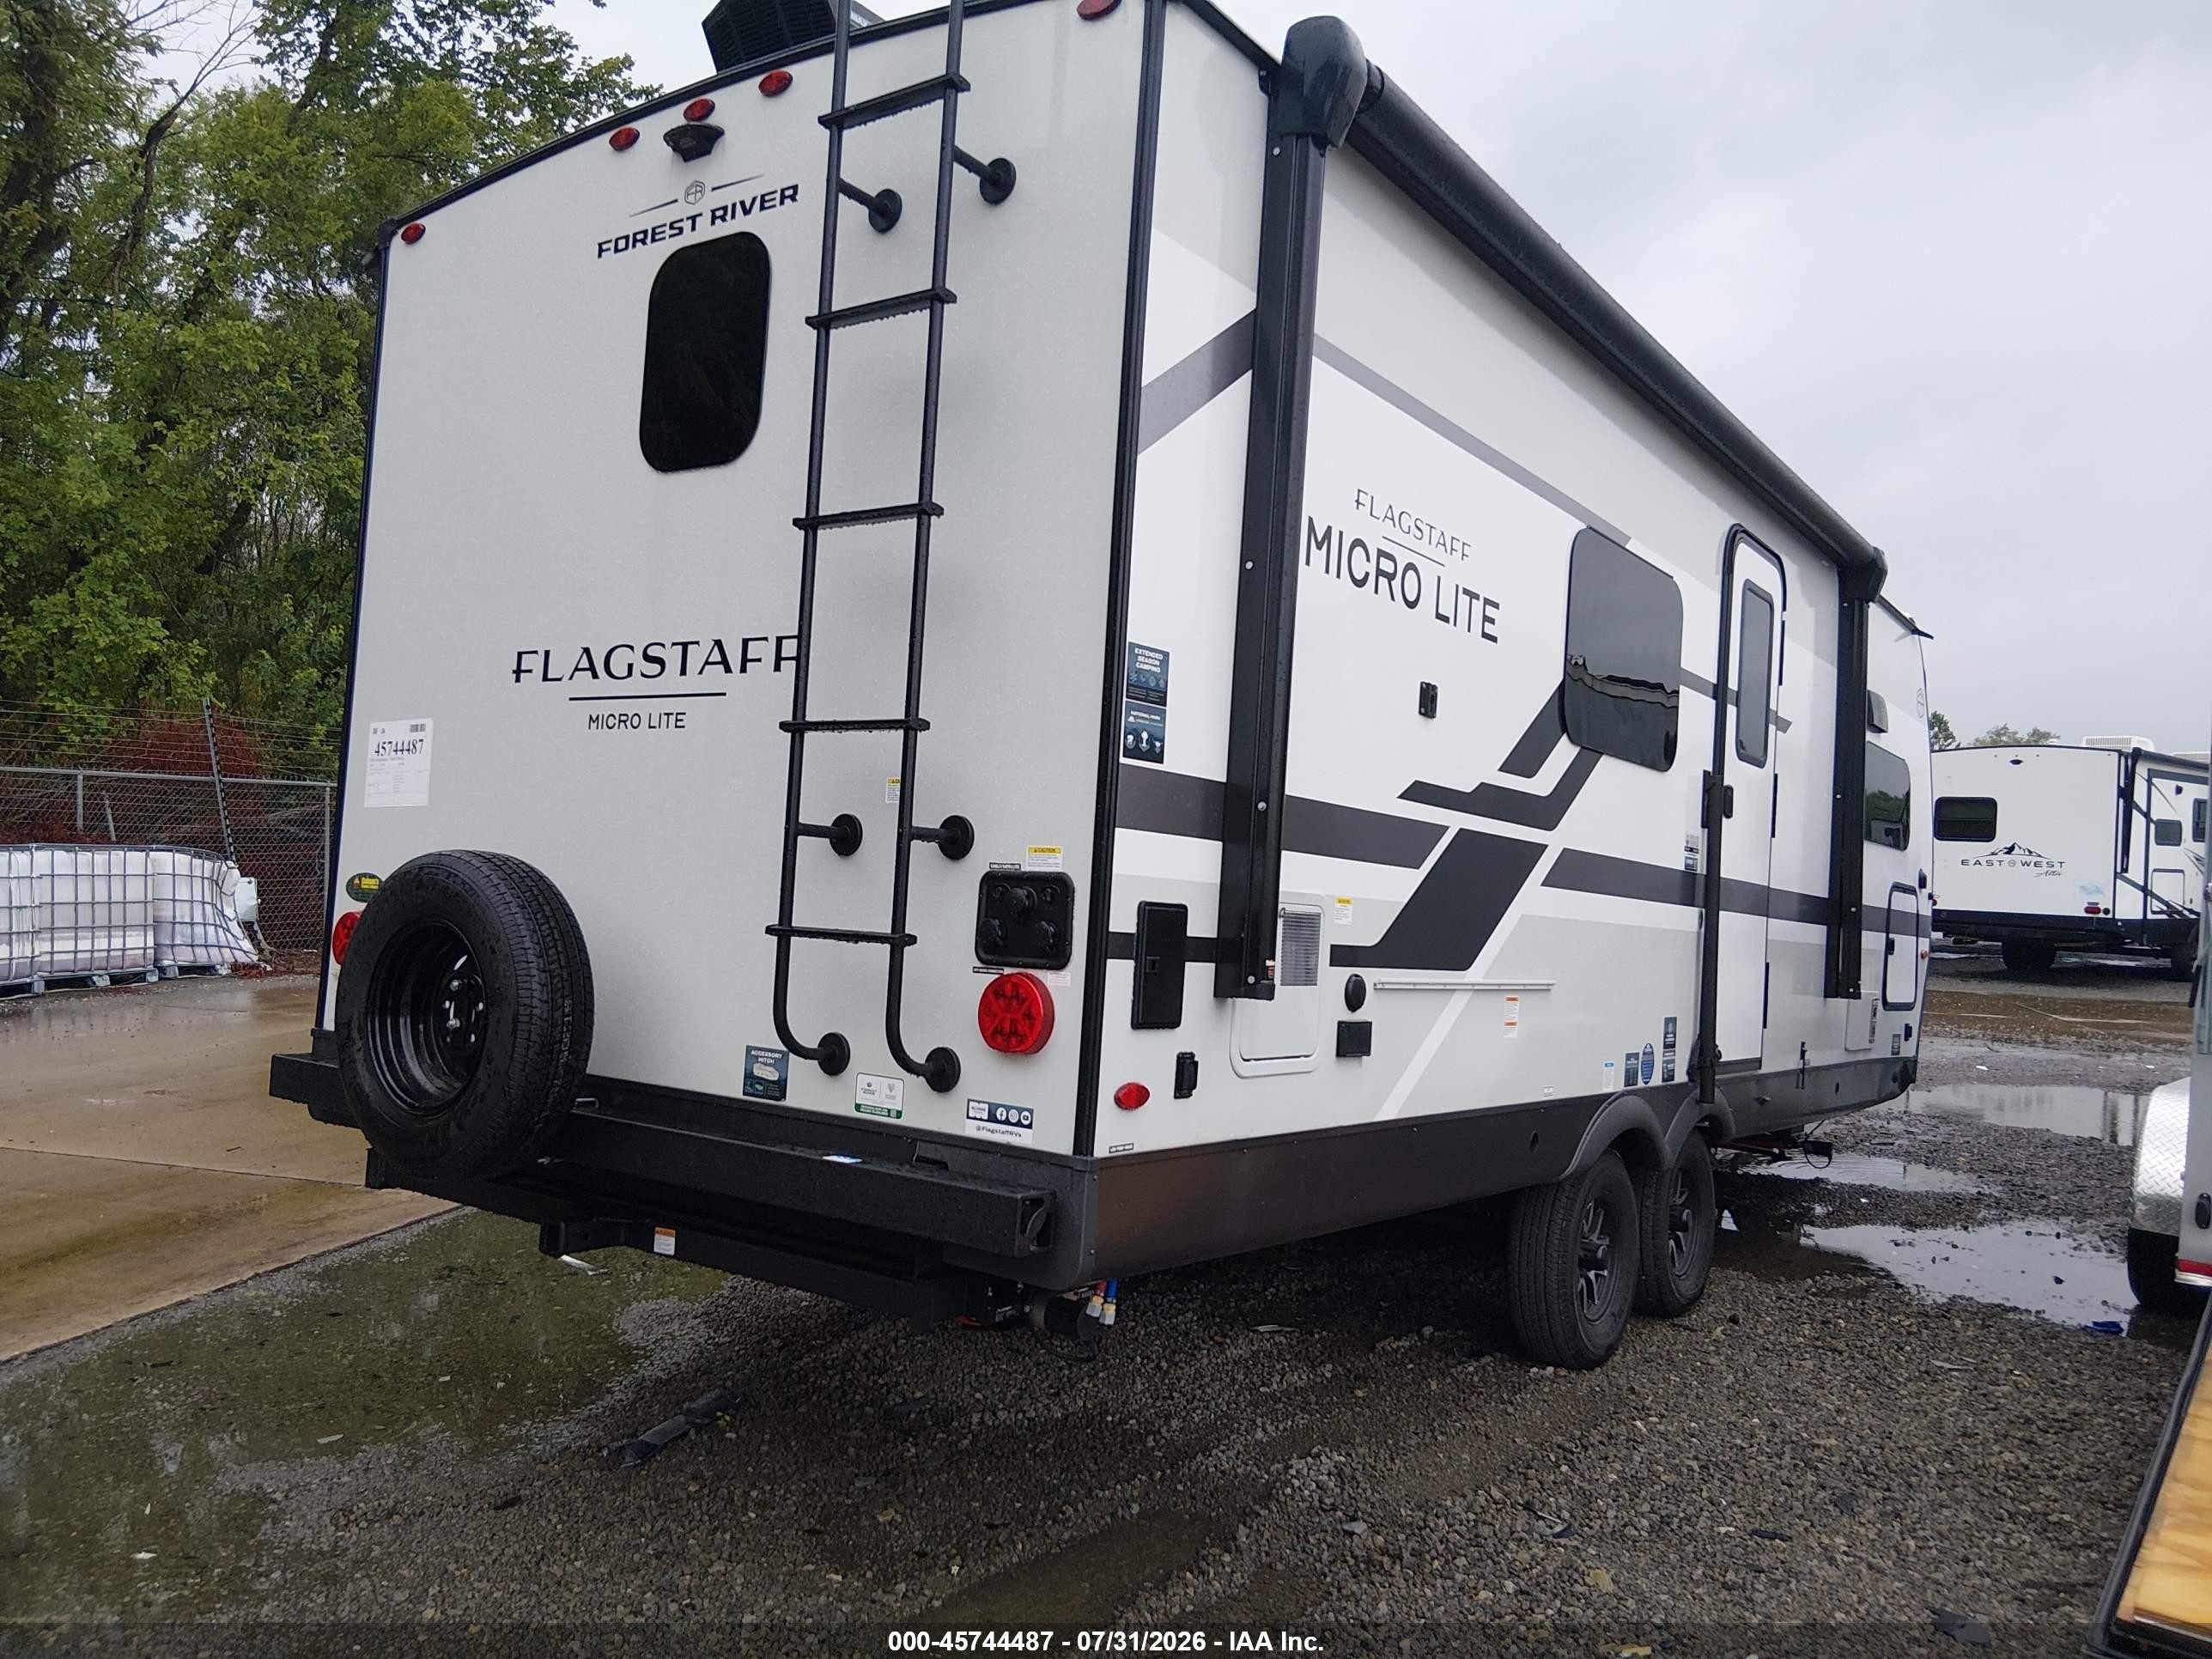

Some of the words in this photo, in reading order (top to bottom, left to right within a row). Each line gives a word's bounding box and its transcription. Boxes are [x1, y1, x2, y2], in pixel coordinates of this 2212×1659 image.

[597, 212, 703, 259] FOREST
[709, 183, 799, 228] RIVER
[1354, 488, 1472, 562] FLAGSTAFF
[1304, 515, 1422, 610] MICRO
[1434, 574, 1501, 645] LITE
[512, 634, 799, 684] FLAGSTAFF
[588, 713, 642, 731] MICRO
[647, 712, 687, 730] LITE
[374, 738, 425, 757] 45744487
[1960, 859, 2005, 867] EAST
[2020, 860, 2066, 869] WEST
